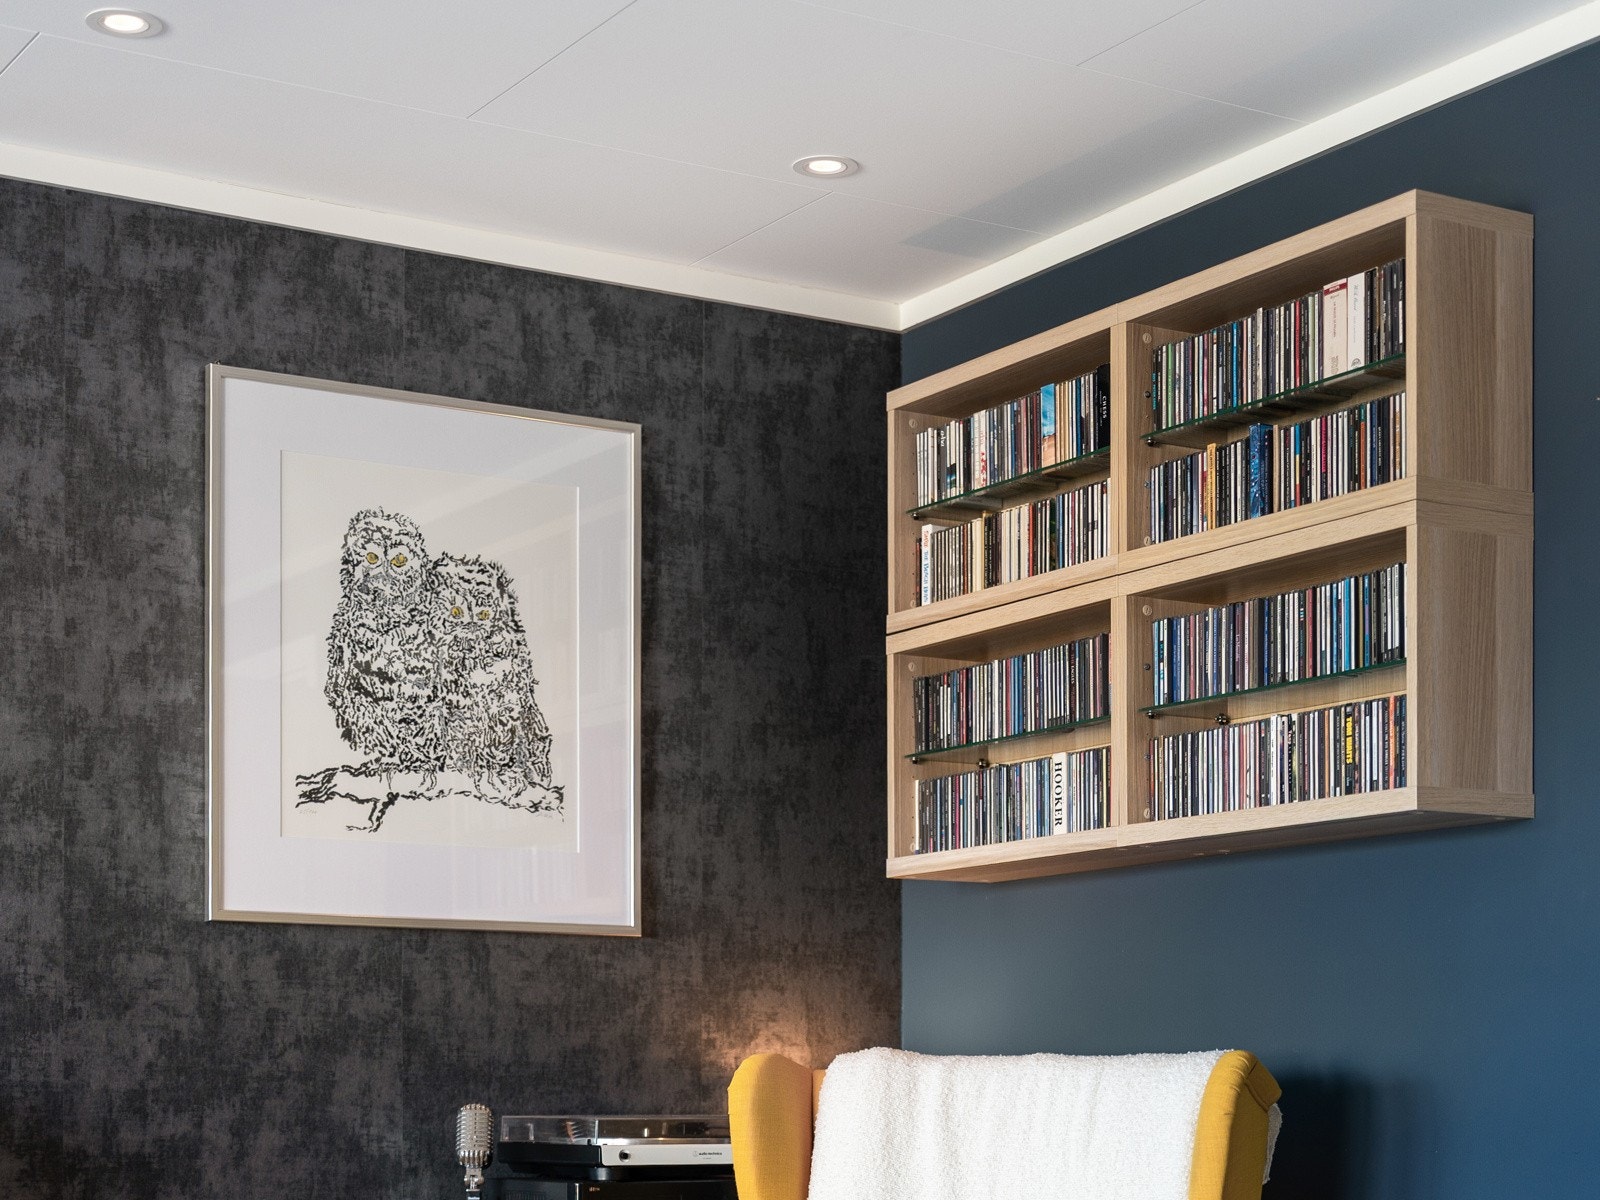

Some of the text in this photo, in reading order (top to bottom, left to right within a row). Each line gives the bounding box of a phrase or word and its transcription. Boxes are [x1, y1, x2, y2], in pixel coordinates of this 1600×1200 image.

[1345, 716, 1353, 764] TOM WAITS
[1054, 762, 1063, 827] HOOKER
